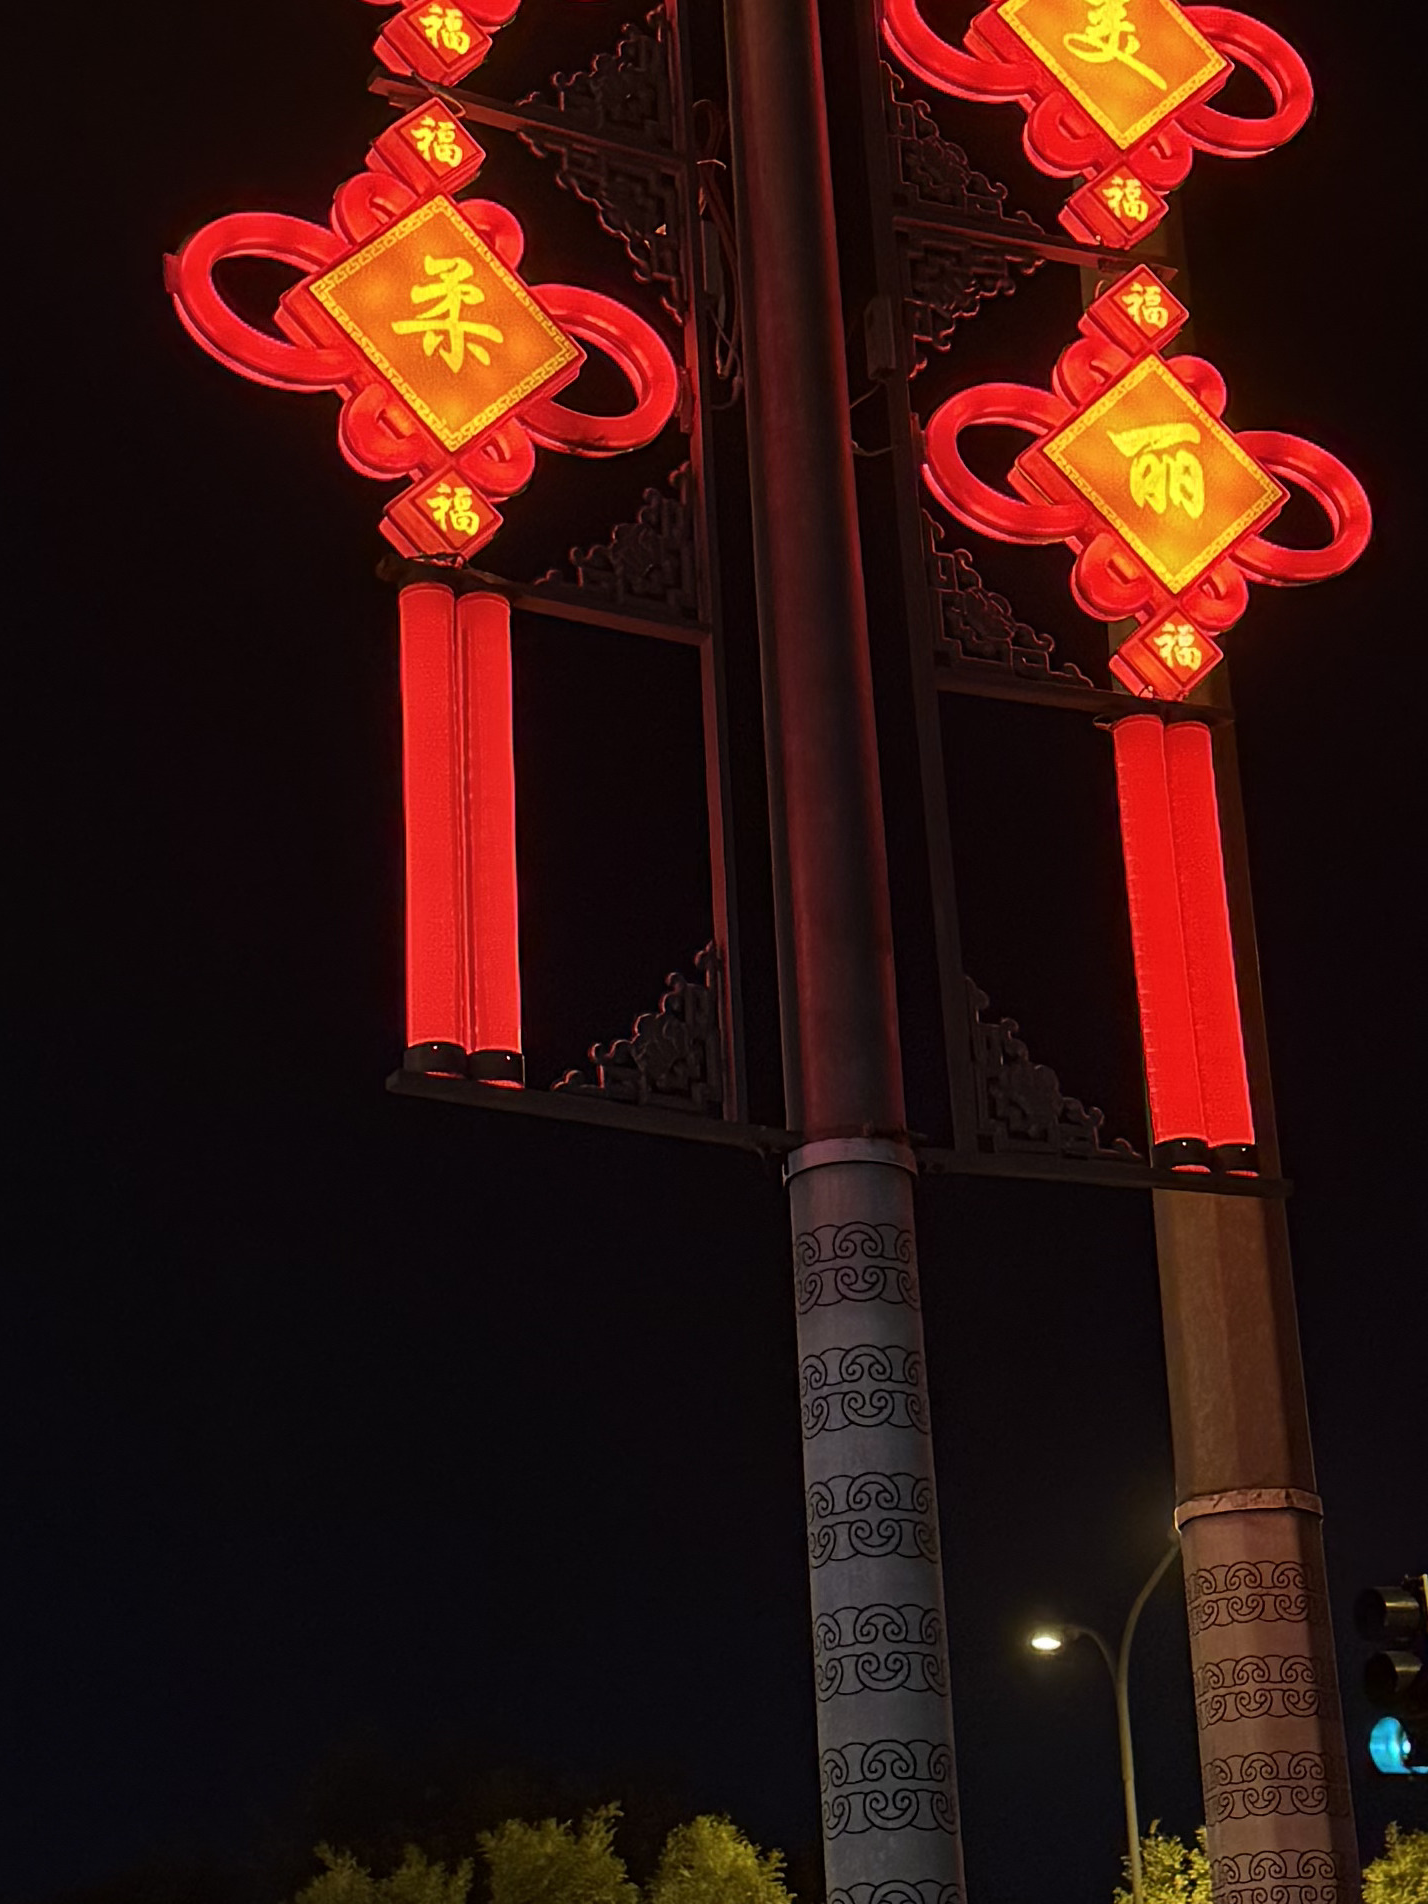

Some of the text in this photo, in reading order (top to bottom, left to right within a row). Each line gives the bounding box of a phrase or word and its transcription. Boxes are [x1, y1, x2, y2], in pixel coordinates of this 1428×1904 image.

[420, 4, 470, 54] 福
[412, 116, 463, 167] 福
[1104, 177, 1149, 222] 福
[391, 254, 504, 374] 柔
[1123, 282, 1169, 329] 福
[1105, 422, 1205, 520] 丽
[428, 484, 480, 536] 福
[1154, 622, 1202, 670] 福
